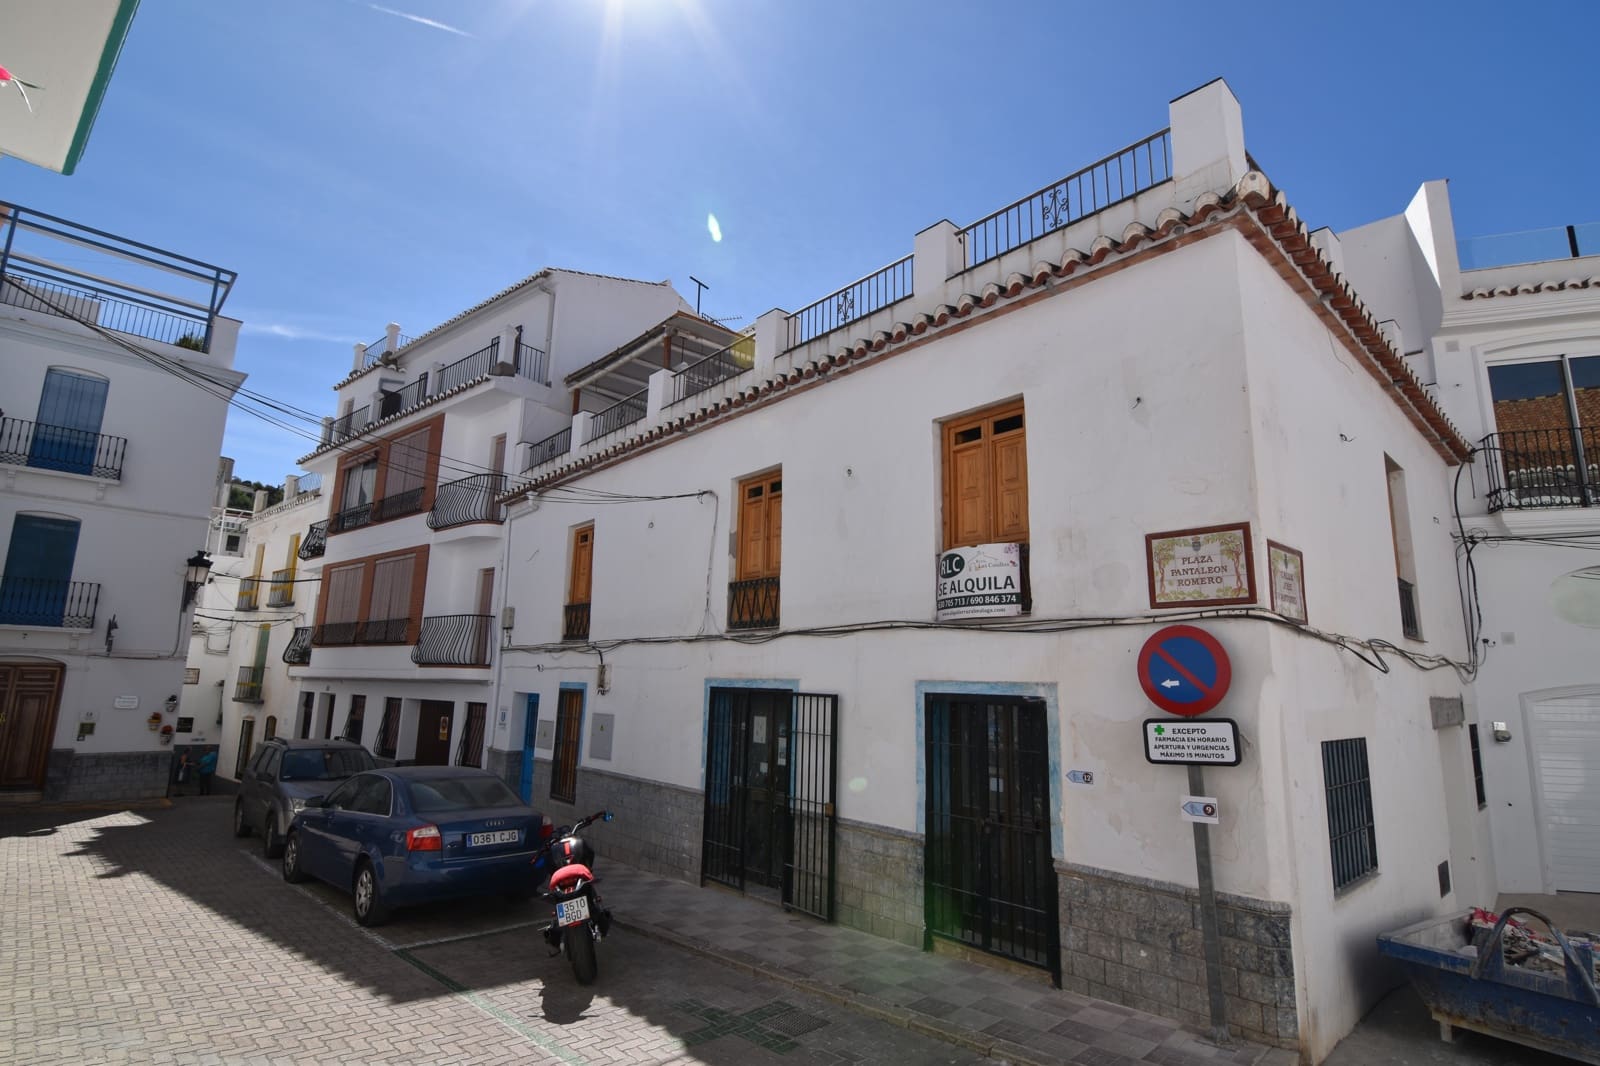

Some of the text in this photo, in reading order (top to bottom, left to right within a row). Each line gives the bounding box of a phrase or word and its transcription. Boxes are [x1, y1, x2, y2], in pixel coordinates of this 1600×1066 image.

[1182, 555, 1213, 565] PLAZA
[941, 556, 961, 576] RLC
[1170, 565, 1228, 577] PANTALEON
[938, 575, 1015, 597] SE ALQUILA
[1177, 576, 1223, 587] ROMERO
[970, 596, 984, 605] 690
[984, 594, 1000, 604] 846
[1206, 806, 1212, 814] 9
[500, 831, 517, 842] CJG
